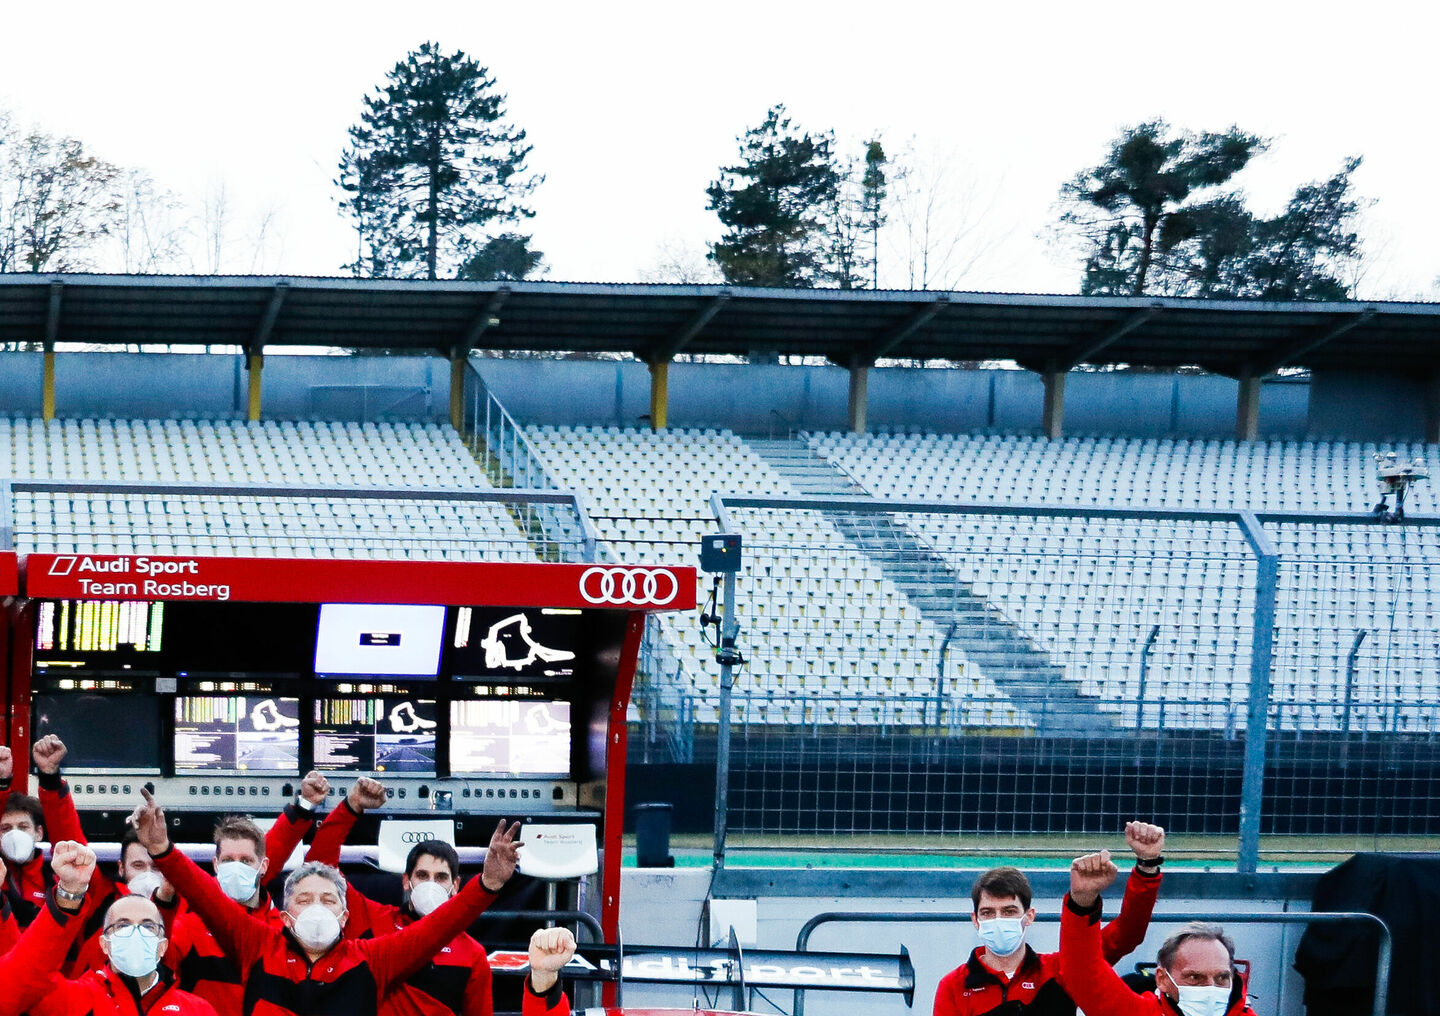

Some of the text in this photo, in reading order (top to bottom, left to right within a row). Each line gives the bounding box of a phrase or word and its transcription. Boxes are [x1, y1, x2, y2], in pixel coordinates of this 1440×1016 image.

[78, 556, 199, 576] Audi Sport
[78, 578, 230, 599] Team Rosberg
